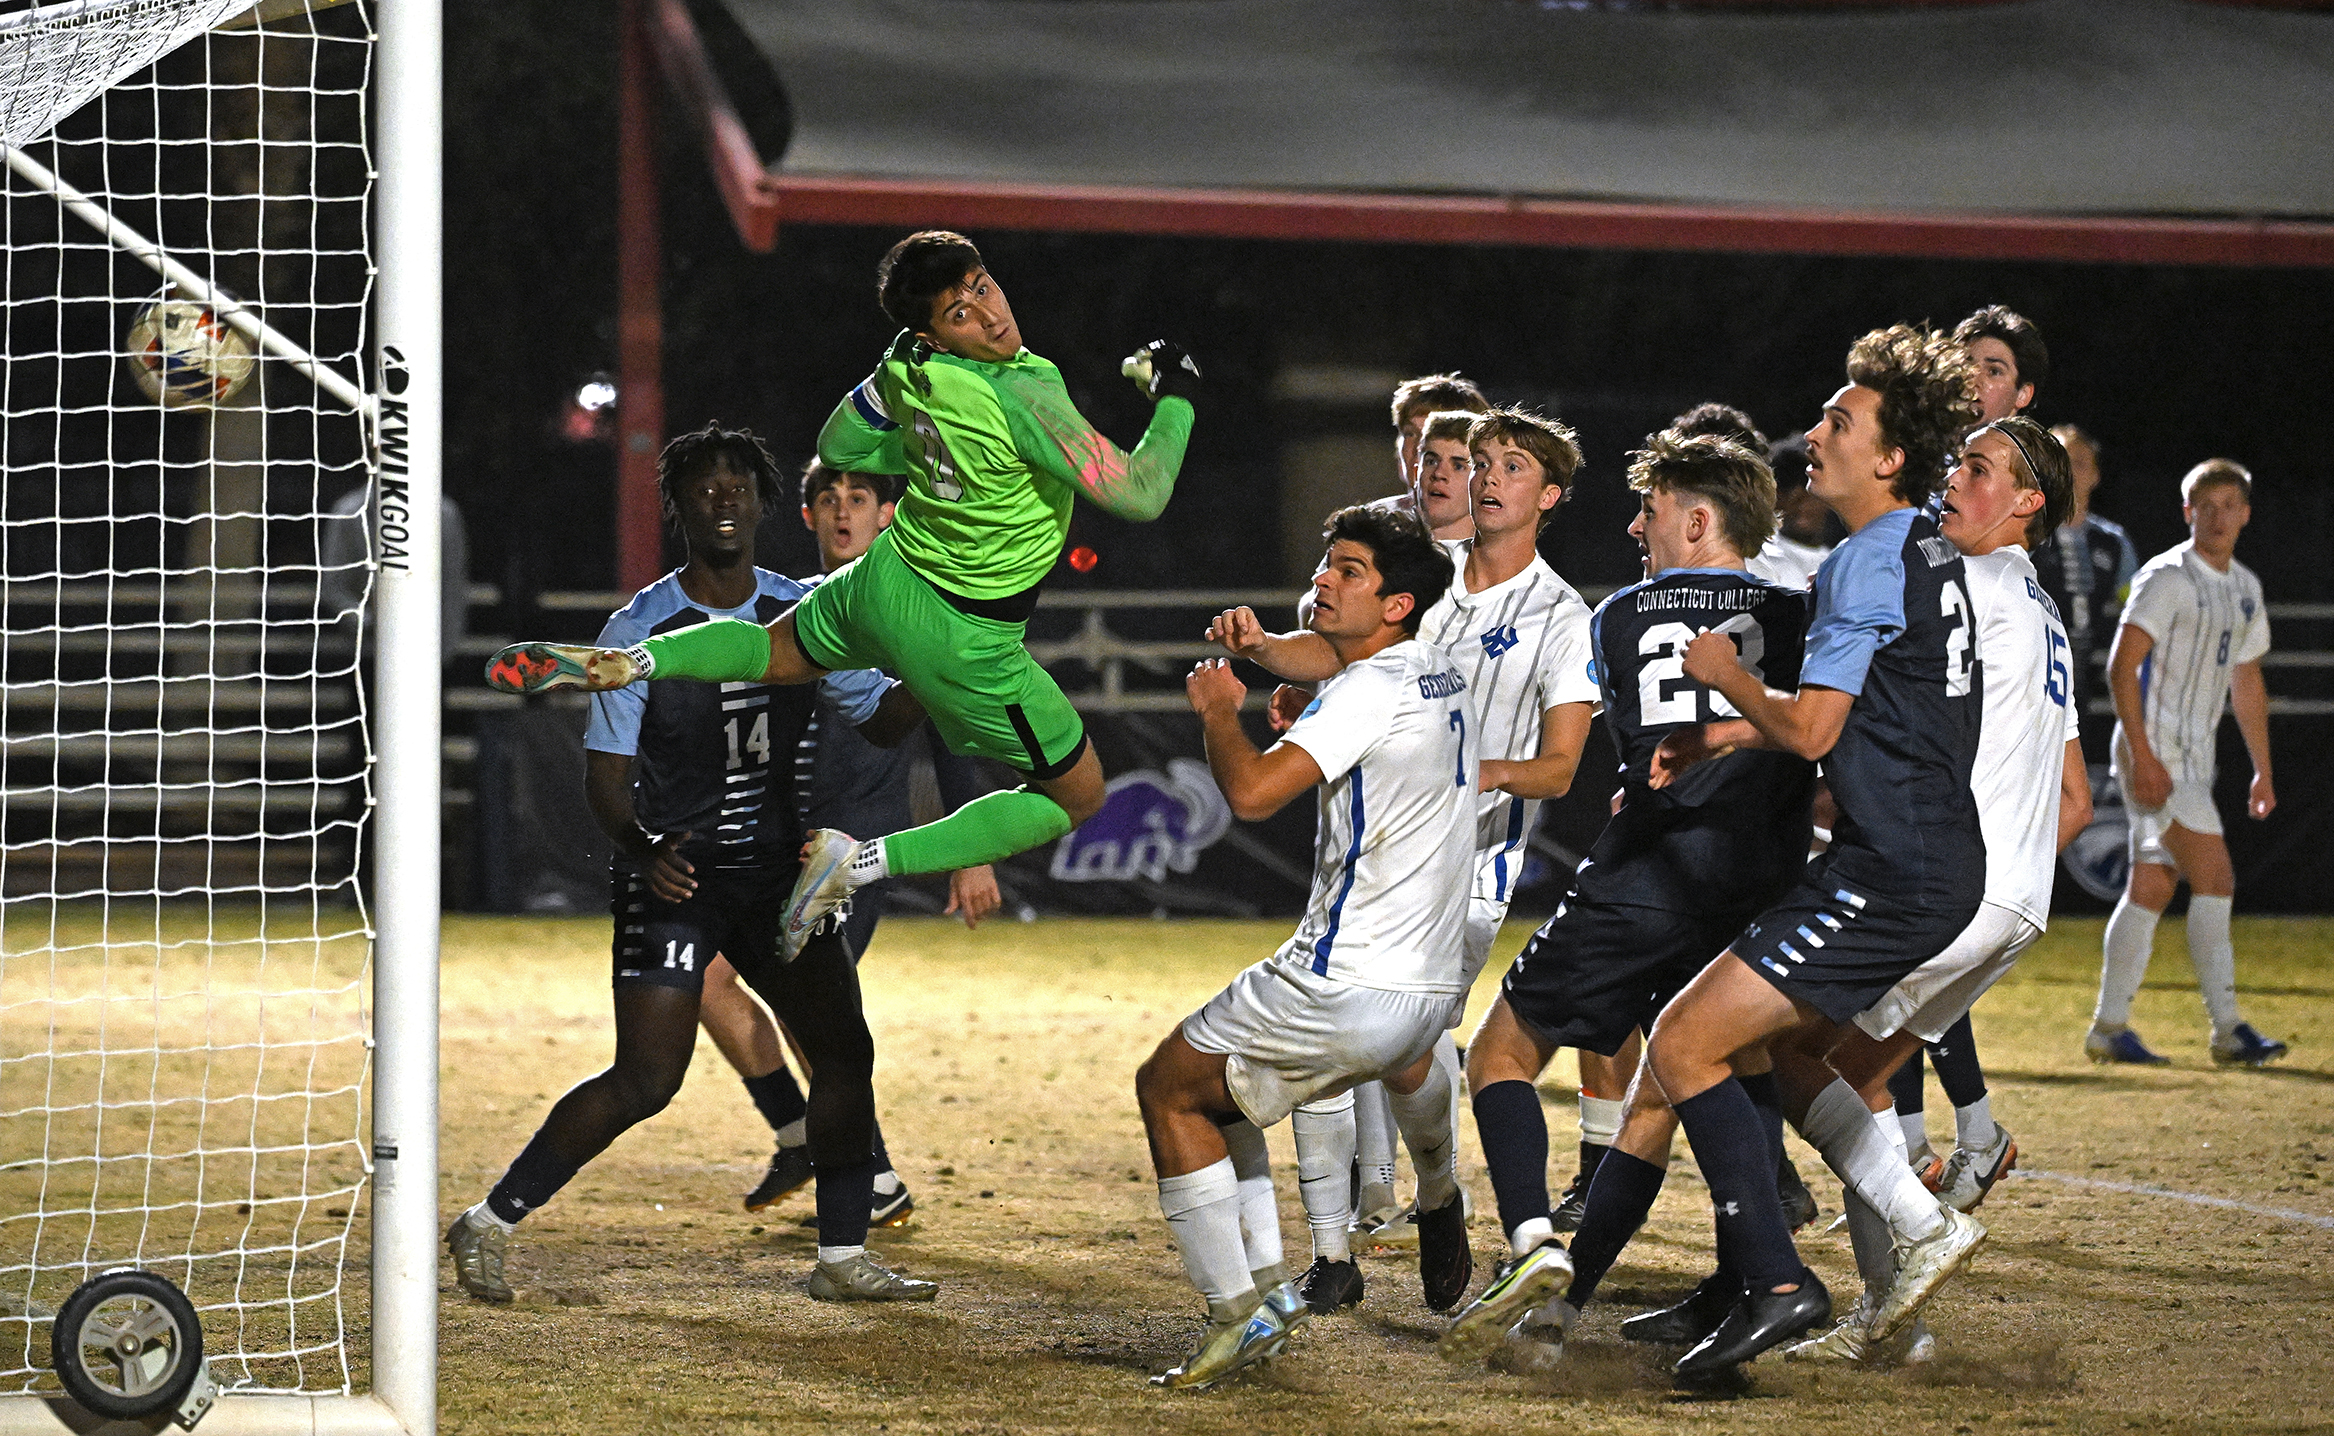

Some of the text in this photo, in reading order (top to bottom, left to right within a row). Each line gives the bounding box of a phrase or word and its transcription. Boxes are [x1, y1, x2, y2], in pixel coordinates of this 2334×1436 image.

[380, 400, 409, 573] KWIKGOAL
[1636, 588, 1714, 613] CONNECTICUT
[2044, 623, 2068, 708] 15
[2217, 630, 2231, 667] 8
[724, 712, 771, 770] 14
[1449, 709, 1467, 788] 7
[664, 940, 694, 971] 14
